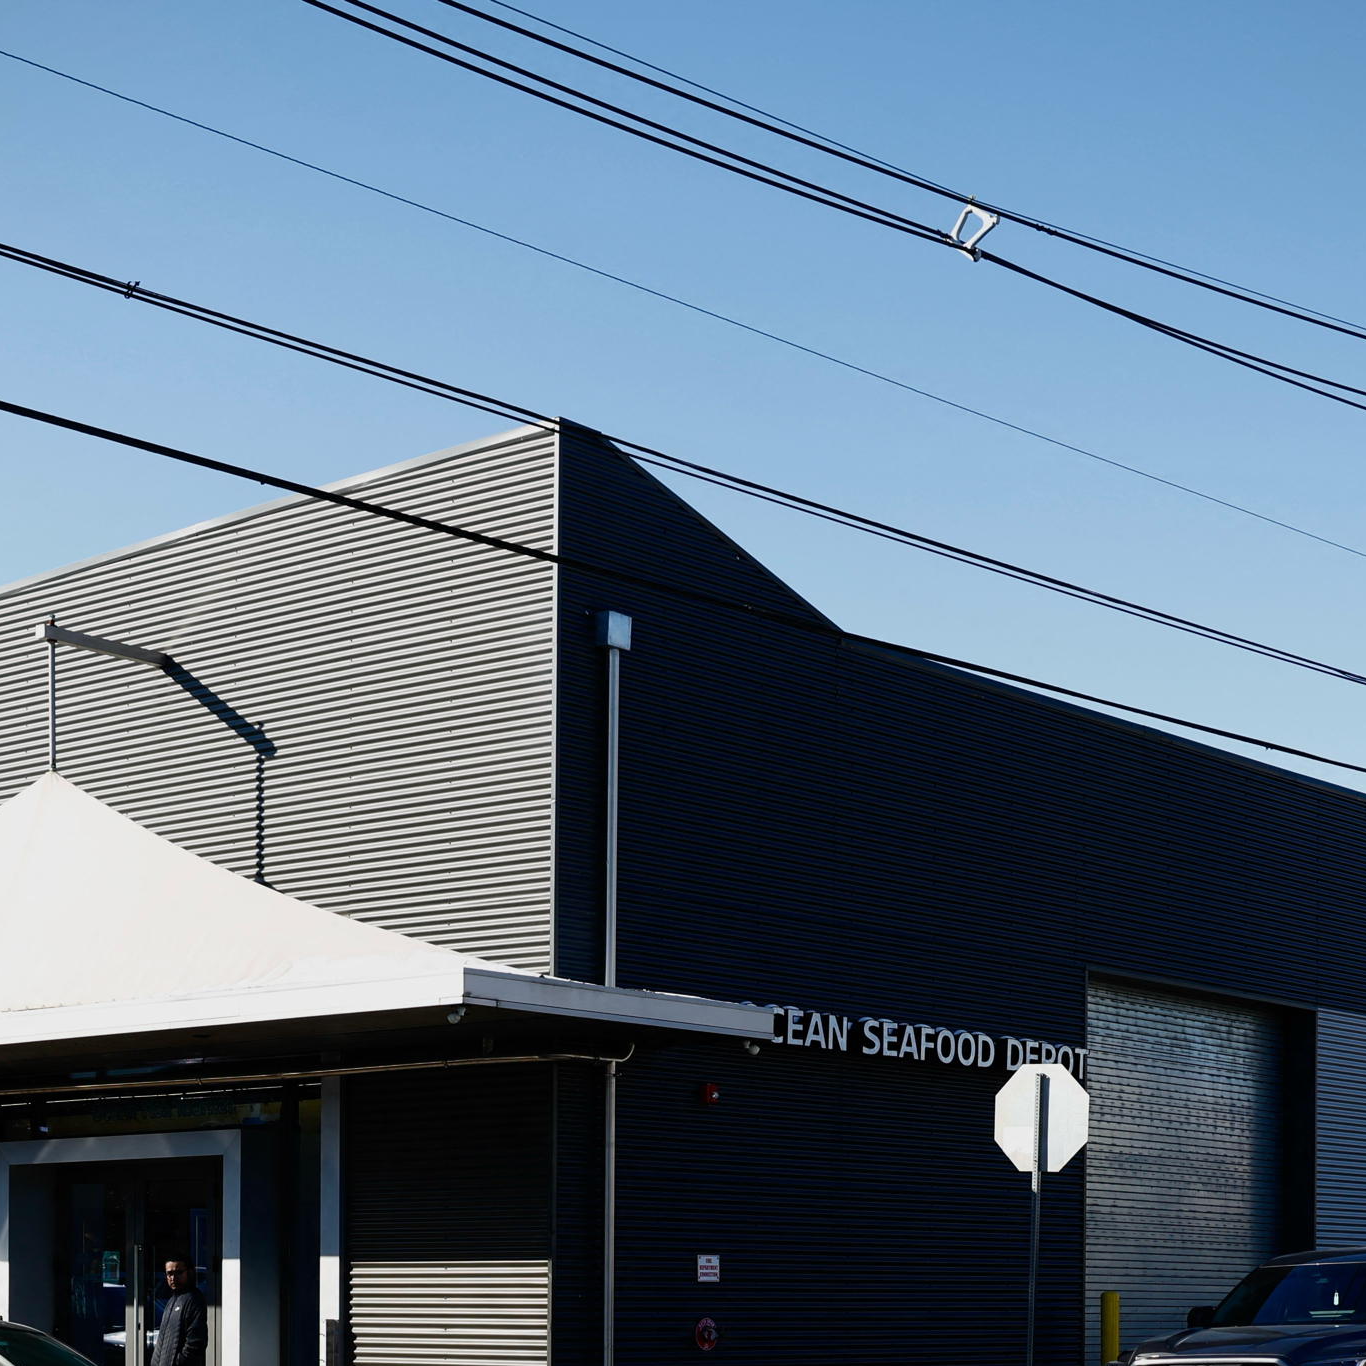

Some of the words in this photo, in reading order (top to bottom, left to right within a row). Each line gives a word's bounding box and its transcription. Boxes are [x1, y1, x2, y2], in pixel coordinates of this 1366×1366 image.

[862, 1019, 996, 1068] SEAFOOD
[92, 1103, 137, 1122] Ocean
[141, 1101, 171, 1119] Fish
[176, 1099, 233, 1117] Market
